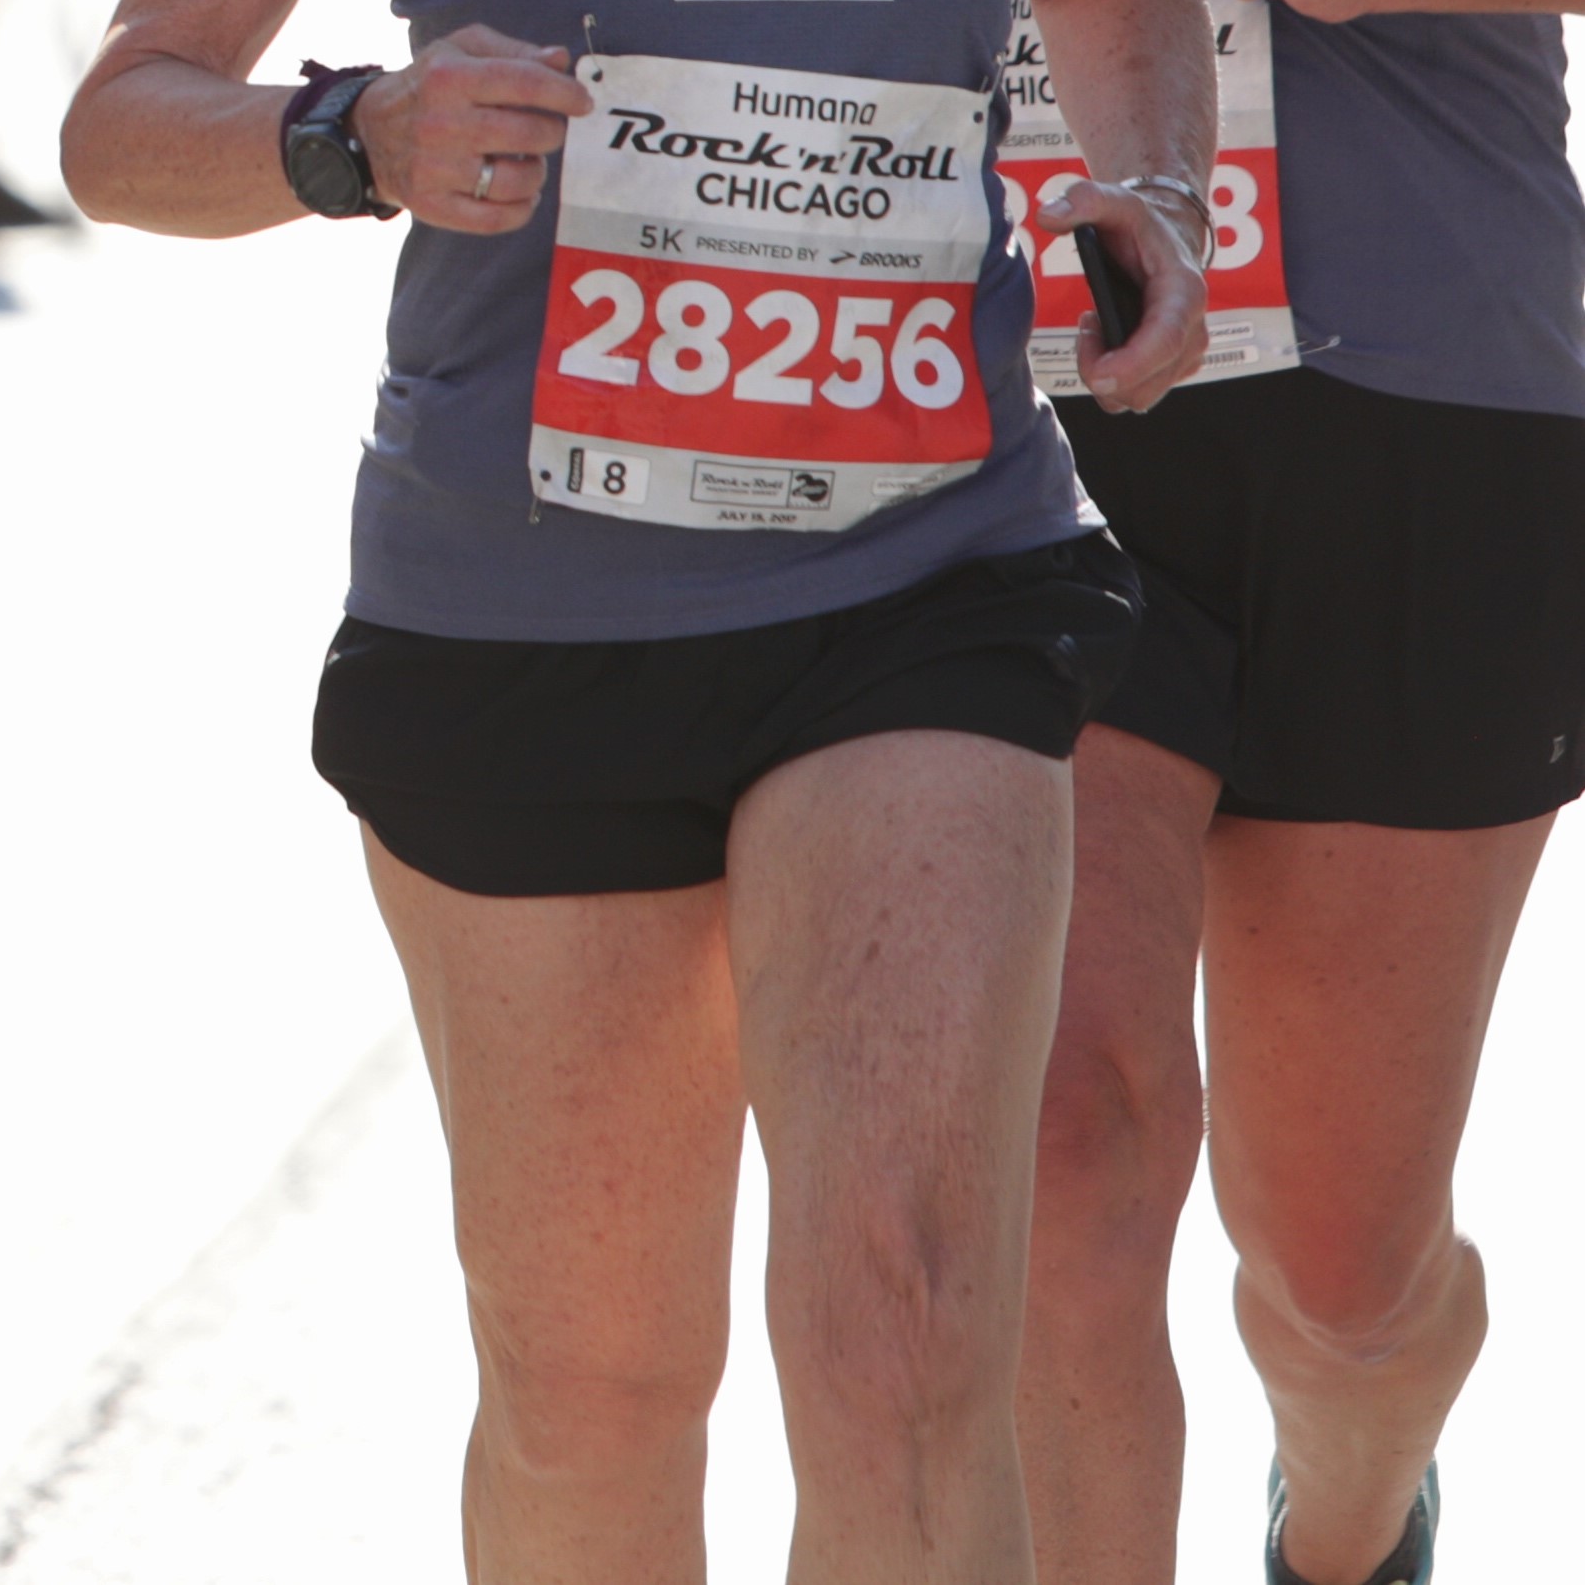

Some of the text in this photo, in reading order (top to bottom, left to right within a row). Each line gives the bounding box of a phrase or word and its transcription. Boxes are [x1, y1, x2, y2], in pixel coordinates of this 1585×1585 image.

[733, 81, 877, 125] Humana
[608, 108, 792, 168] Rock
[848, 134, 959, 181] Roll
[696, 172, 891, 220] CHICAGO
[640, 224, 923, 270] 5K PRESENTED BY BROOKS
[558, 268, 964, 410] 28256
[604, 461, 626, 494] 8
